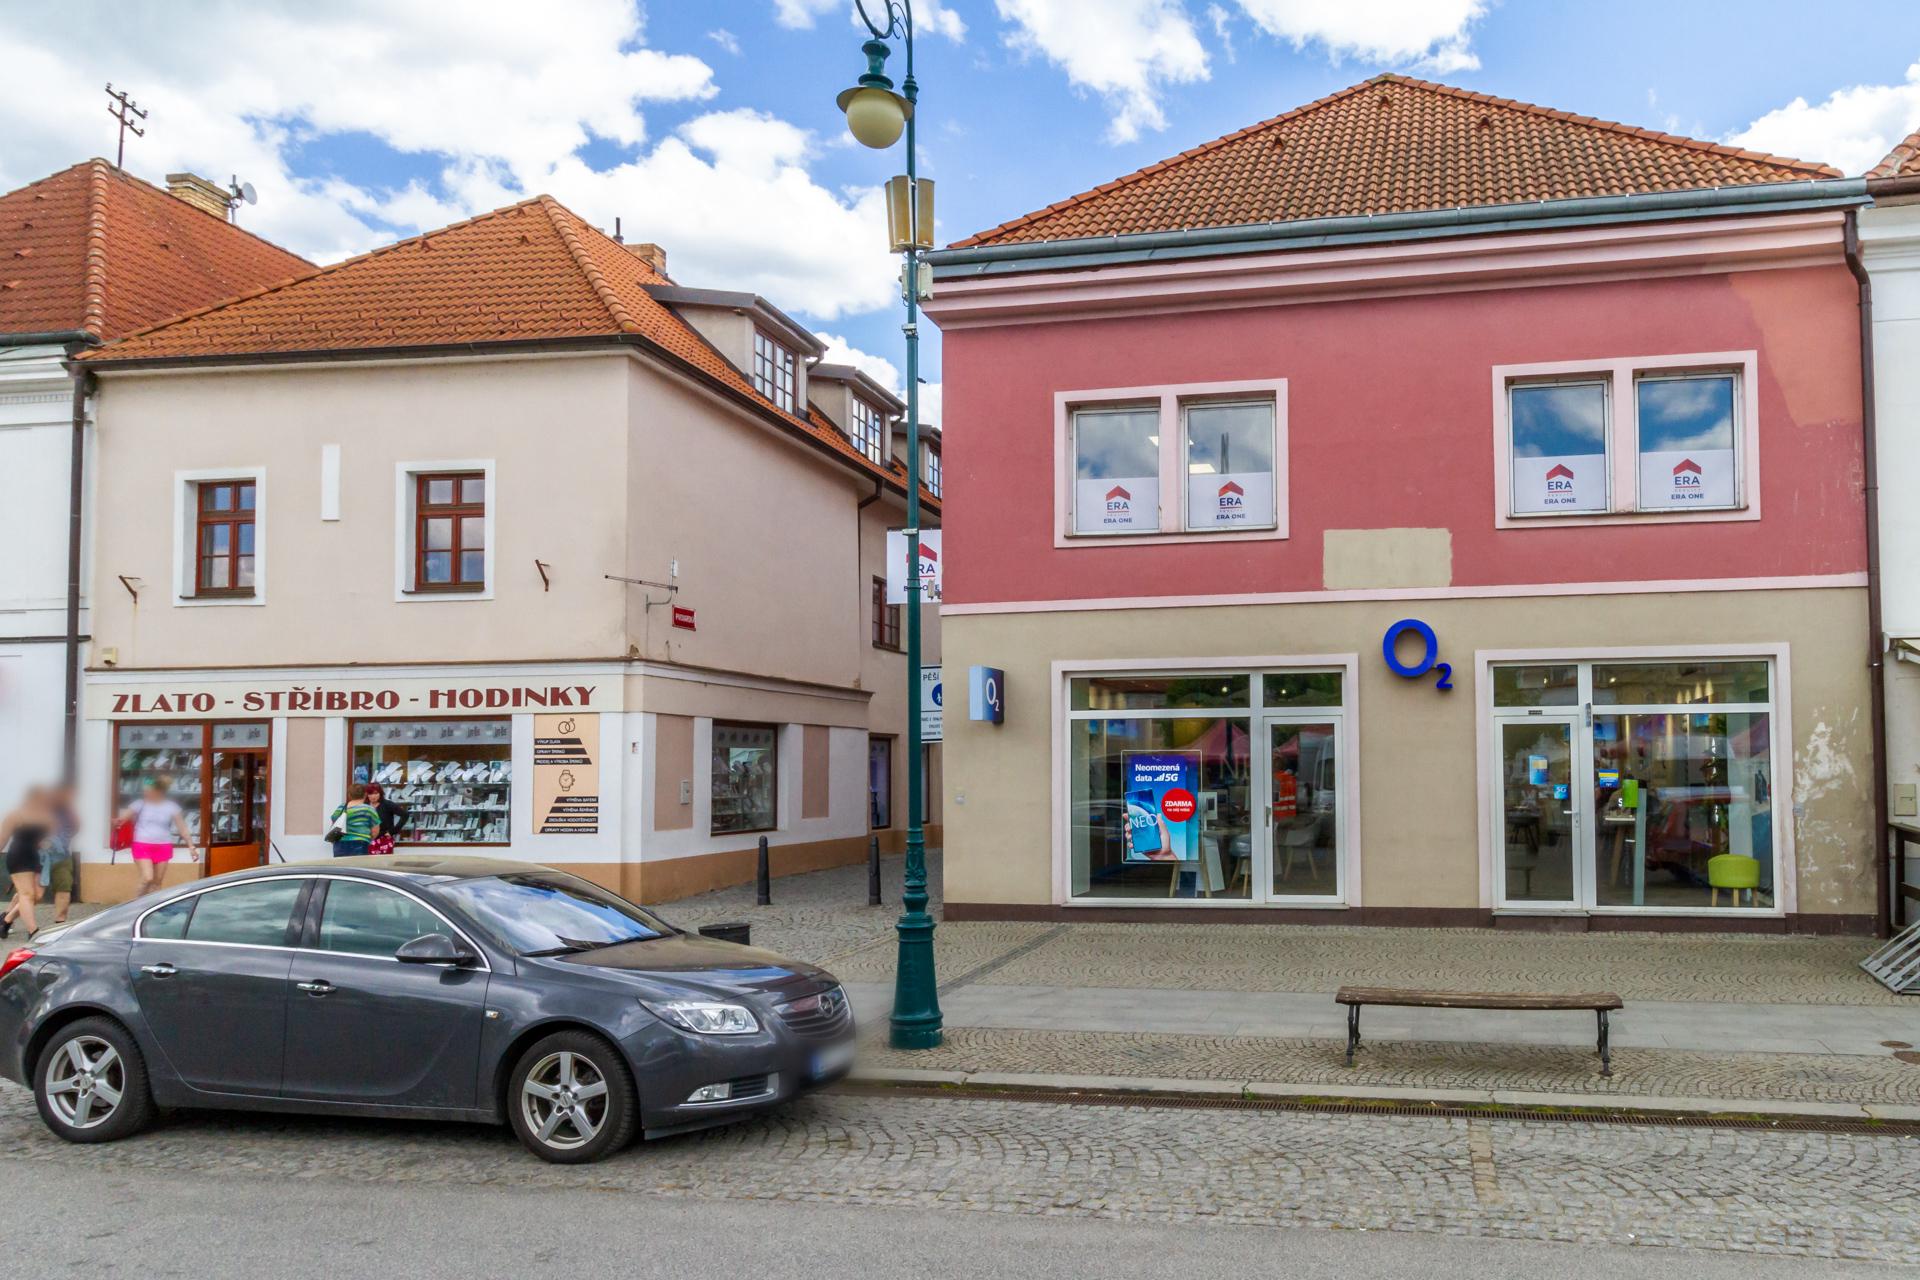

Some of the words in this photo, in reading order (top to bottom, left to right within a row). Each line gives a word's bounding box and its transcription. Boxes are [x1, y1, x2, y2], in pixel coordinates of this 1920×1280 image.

[1547, 481, 1573, 490] ERA
[1674, 476, 1700, 486] ERA
[1107, 502, 1129, 510] ERA
[1219, 497, 1242, 506] ERA
[1382, 618, 1453, 689] O2
[111, 692, 216, 713] ZLATO
[243, 686, 400, 712] STŘÍBRO
[429, 685, 597, 709] HODINKY
[985, 678, 999, 712] O2
[1135, 763, 1180, 772] Neomezená
[1135, 774, 1153, 782] data
[1165, 773, 1179, 782] 5G
[1164, 800, 1193, 808] ZDARMA
[1129, 813, 1158, 829] NEO
